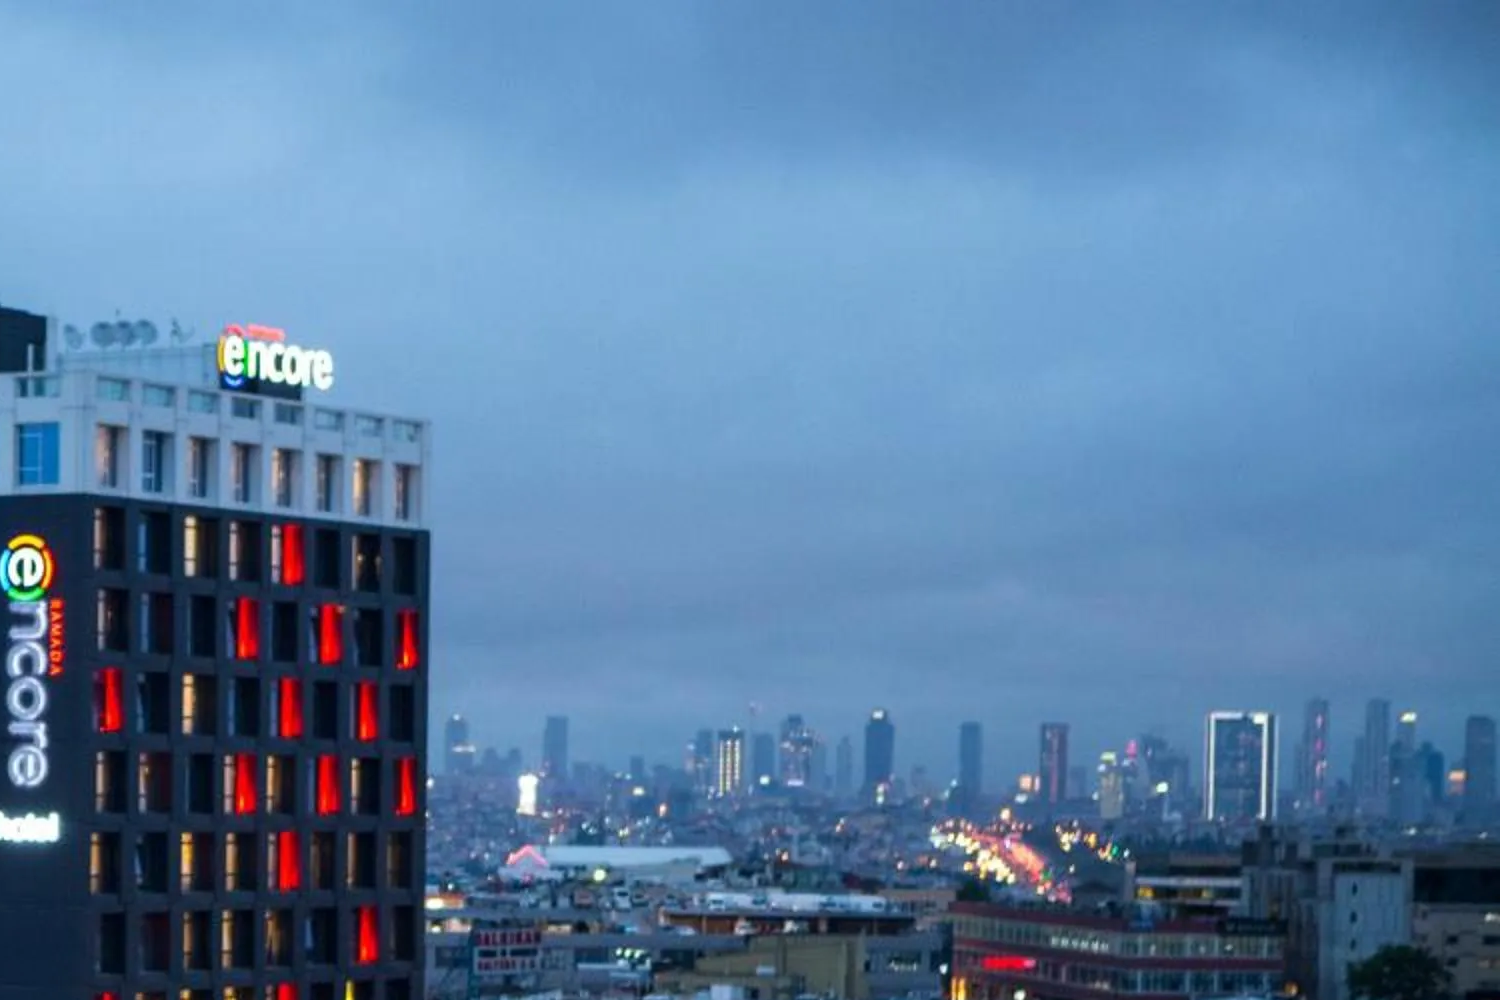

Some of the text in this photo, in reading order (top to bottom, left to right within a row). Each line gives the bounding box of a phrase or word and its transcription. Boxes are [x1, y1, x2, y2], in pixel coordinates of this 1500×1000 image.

[224, 334, 334, 391] encore
[5, 545, 49, 787] encore
[50, 597, 65, 677] RAMADA
